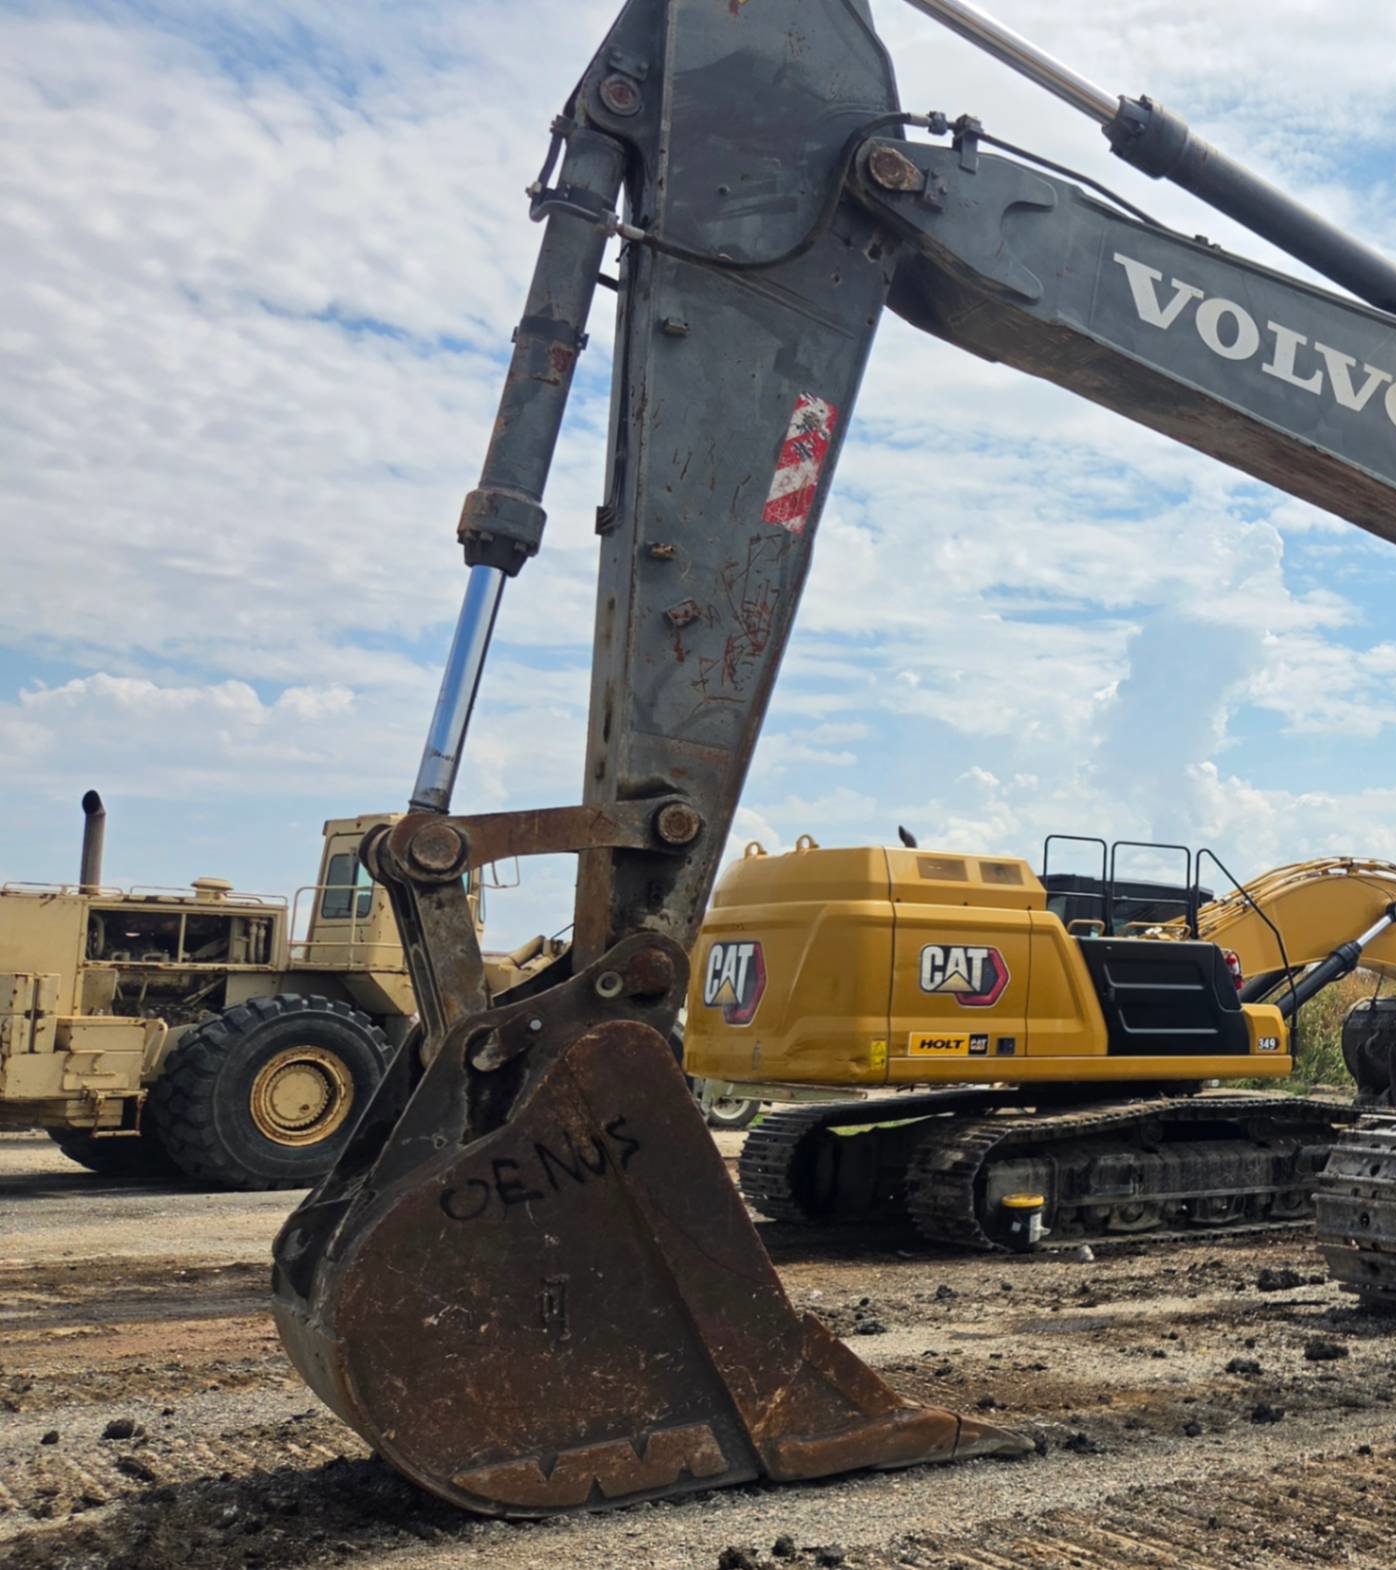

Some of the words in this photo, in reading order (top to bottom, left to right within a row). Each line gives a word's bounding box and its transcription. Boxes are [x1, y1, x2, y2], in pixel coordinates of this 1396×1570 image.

[704, 944, 754, 1004] CAT
[921, 946, 988, 992] CAT
[919, 1038, 965, 1050] HOLT
[1258, 1037, 1276, 1050] 349
